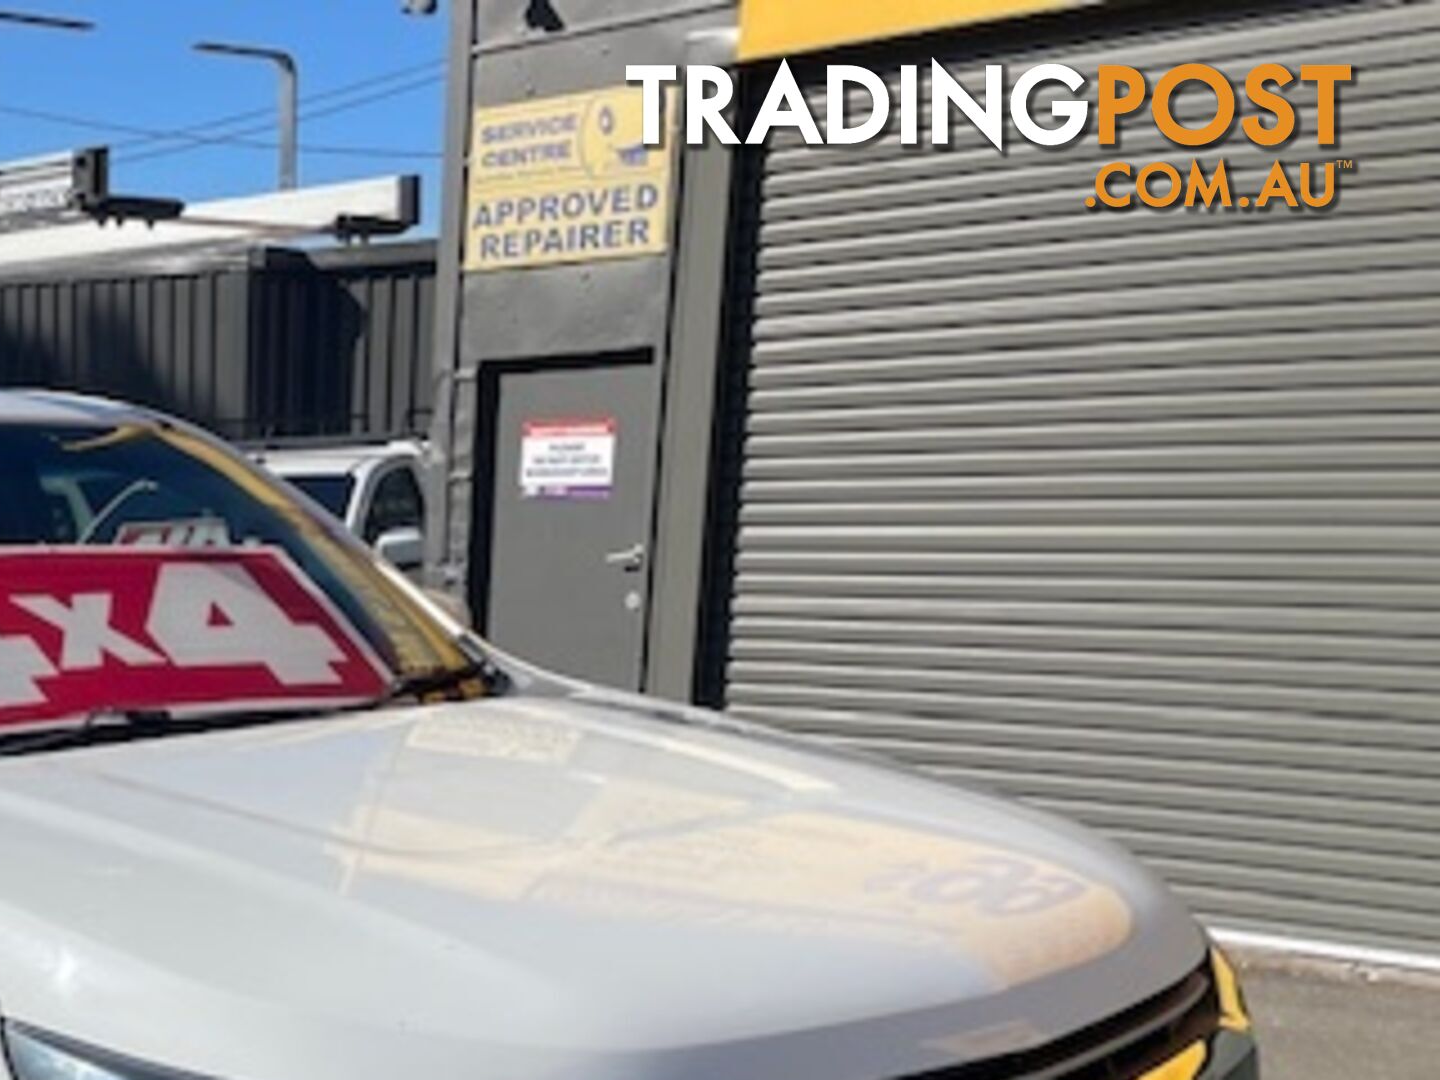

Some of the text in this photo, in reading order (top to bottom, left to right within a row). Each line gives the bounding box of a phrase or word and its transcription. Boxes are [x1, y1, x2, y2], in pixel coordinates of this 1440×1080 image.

[481, 113, 577, 144] SERVICE
[481, 140, 572, 168] CENTRE
[473, 184, 659, 230] APPROVED
[480, 219, 650, 261] REPAIRER
